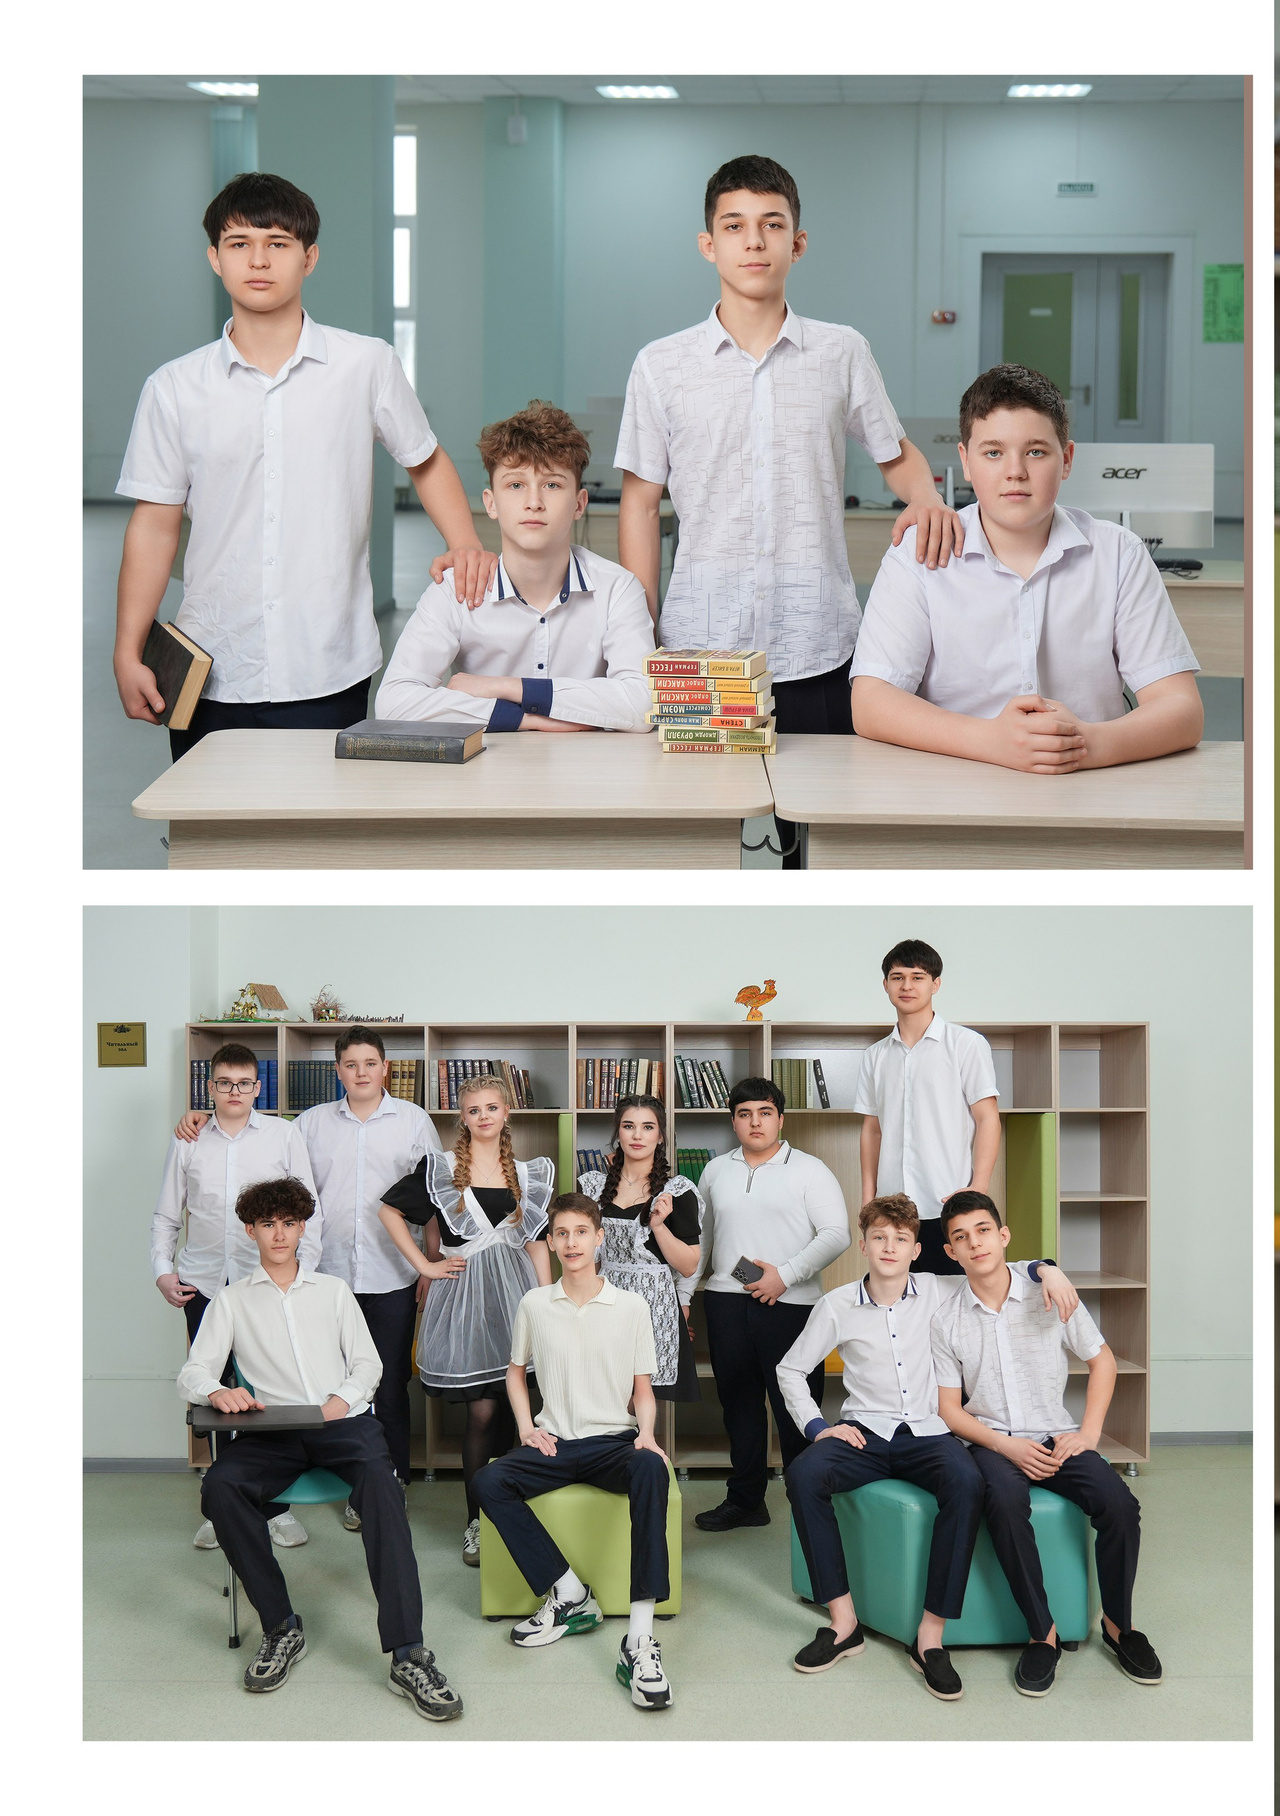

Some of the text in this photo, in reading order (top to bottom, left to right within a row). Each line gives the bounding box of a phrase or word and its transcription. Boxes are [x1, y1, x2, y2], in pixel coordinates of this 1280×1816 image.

[933, 434, 961, 444] ace
[1102, 467, 1147, 479] acer
[651, 664, 673, 672] ГЕССЕ
[657, 679, 685, 688] ХАКСЛИ
[660, 693, 689, 701] ХАКСЛИ
[662, 705, 685, 713] МОЭМ
[652, 716, 674, 724] САРТР
[667, 731, 694, 739] ОРУЭЛЛ
